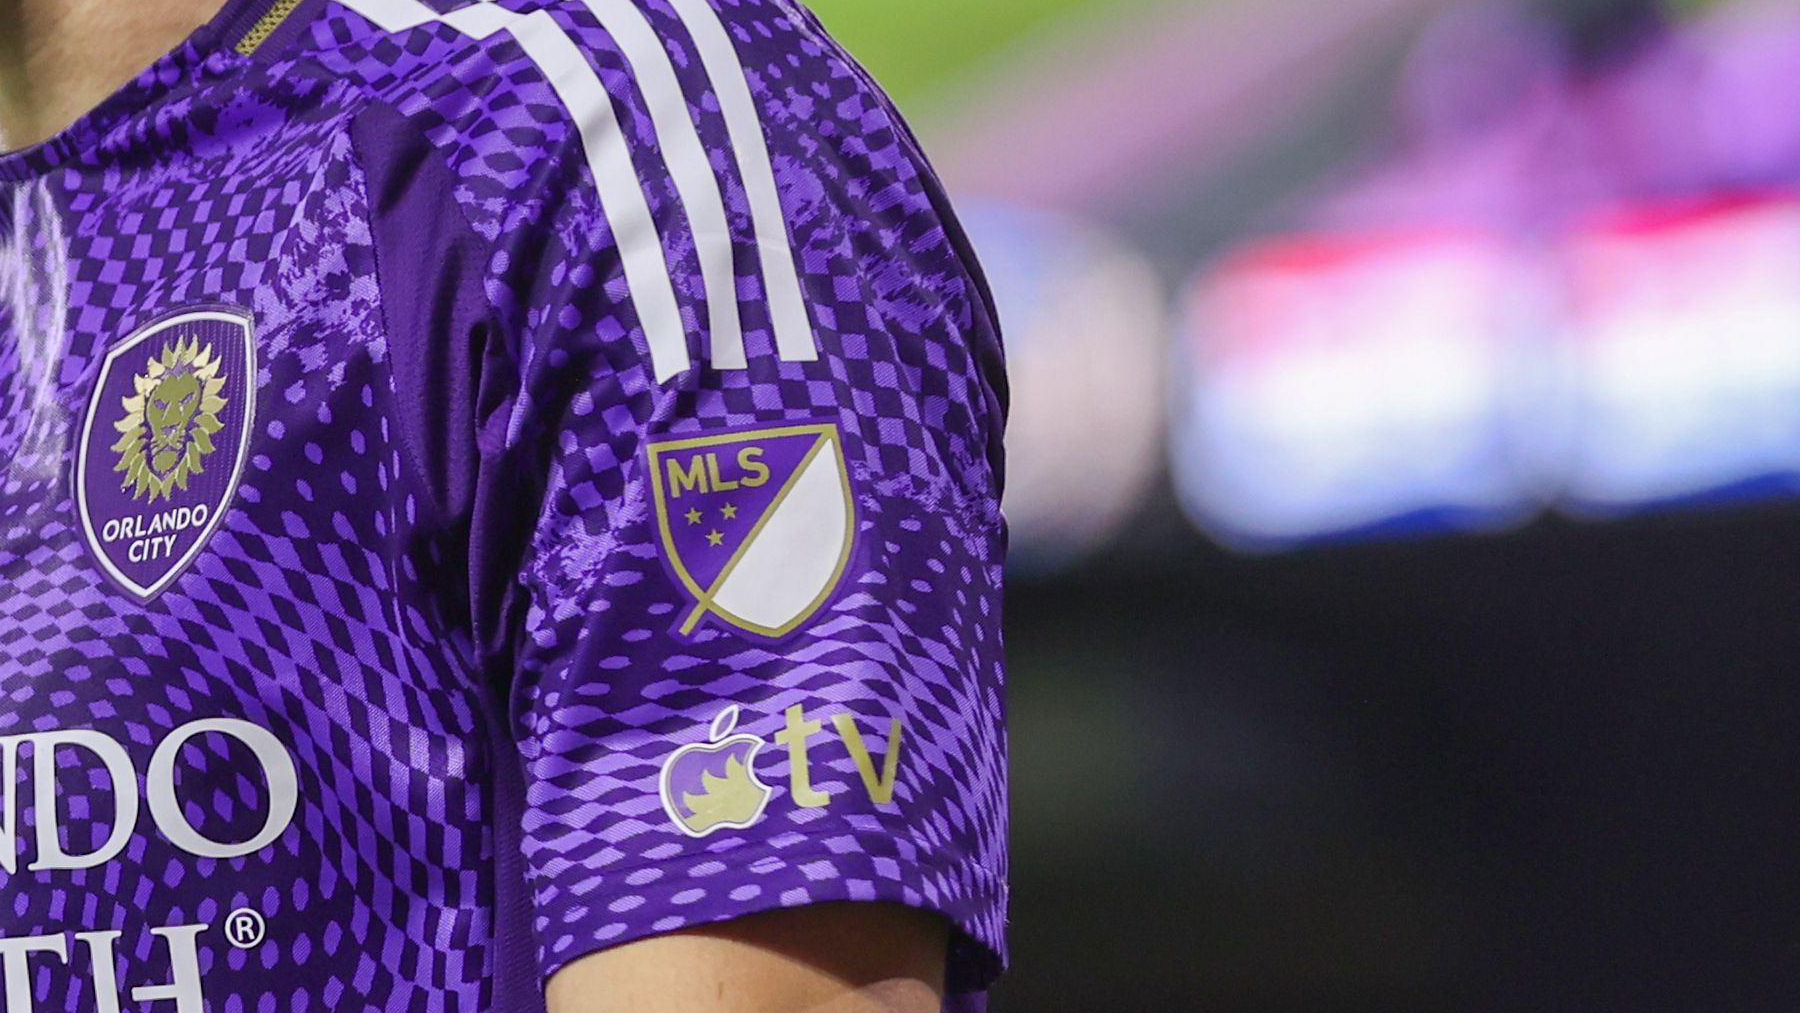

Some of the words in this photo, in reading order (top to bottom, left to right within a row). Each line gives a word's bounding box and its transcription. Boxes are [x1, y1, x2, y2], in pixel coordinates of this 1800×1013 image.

[666, 446, 771, 499] MLS
[102, 503, 209, 542] ORLANDO
[128, 534, 177, 563] CITY
[774, 703, 901, 808] tv
